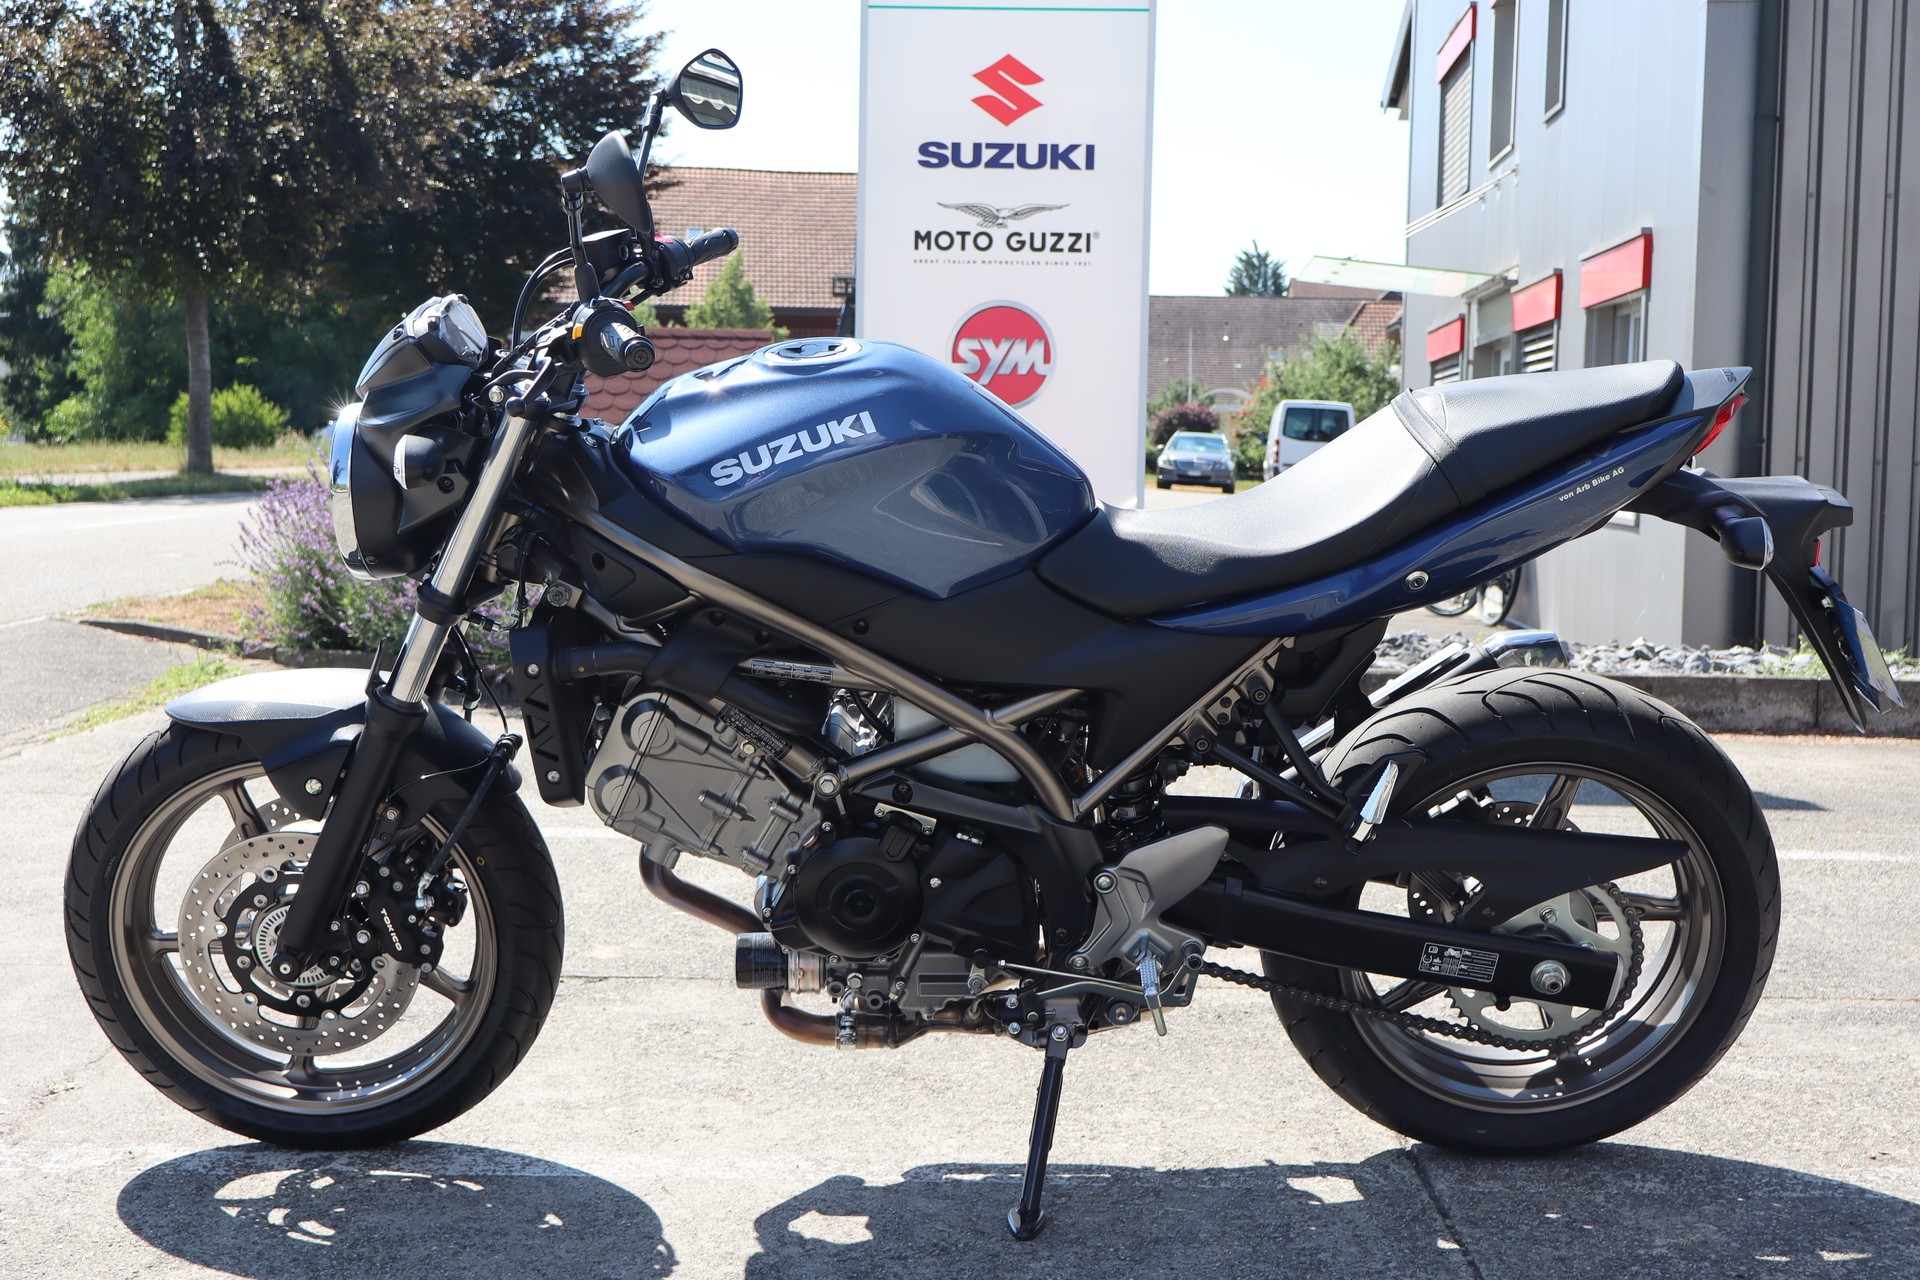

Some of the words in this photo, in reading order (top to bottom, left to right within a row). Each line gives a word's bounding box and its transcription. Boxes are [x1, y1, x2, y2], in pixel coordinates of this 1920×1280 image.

[917, 141, 1095, 170] SUZUKI
[914, 230, 994, 253] MOTO
[955, 337, 1051, 385] SYM
[710, 411, 877, 487] SUZUKI
[1558, 491, 1574, 502] von
[1576, 484, 1591, 495] Arb
[1592, 474, 1611, 487] Bike
[1612, 466, 1625, 478] AG
[380, 908, 403, 951] TOKICO
